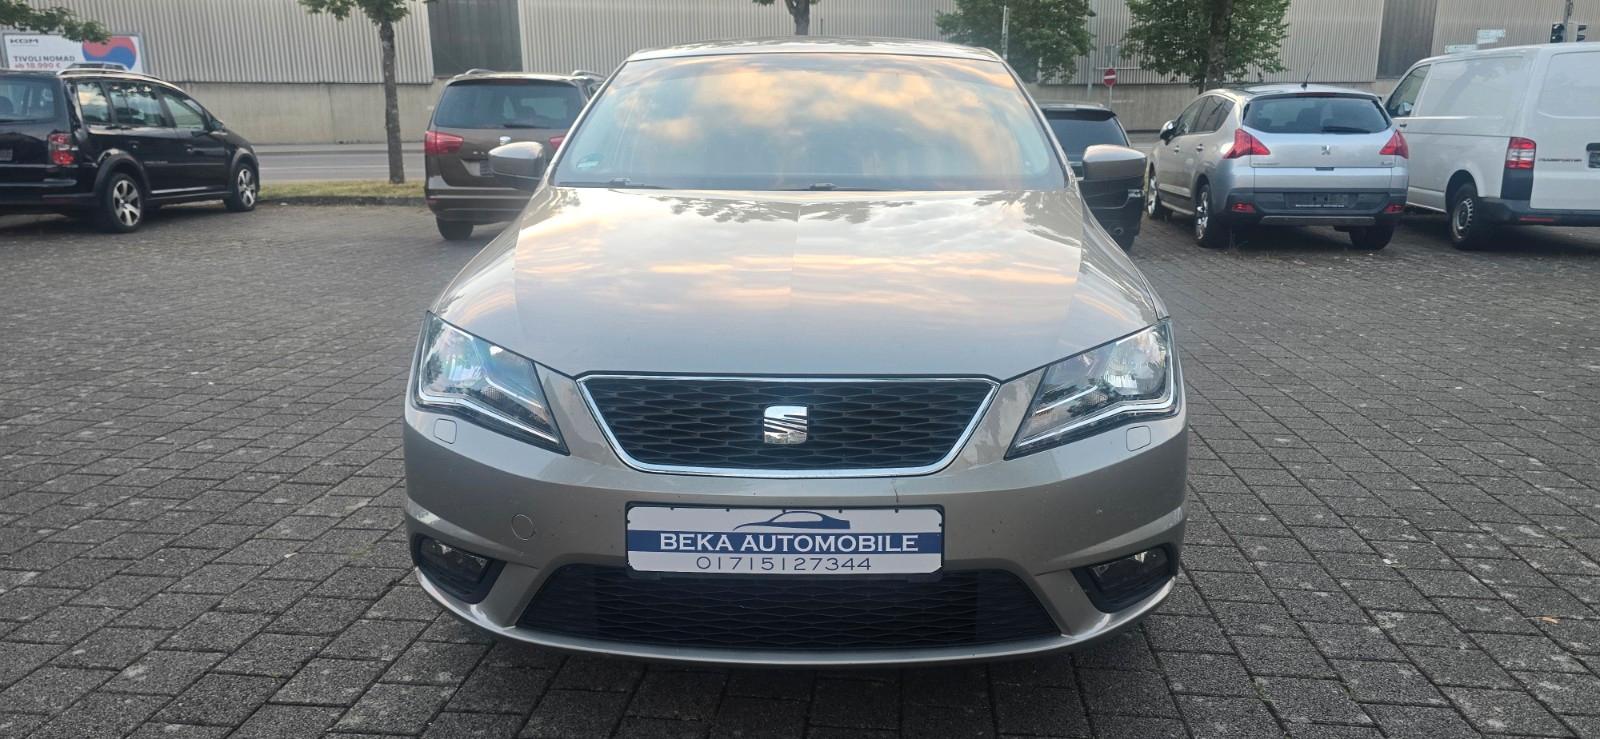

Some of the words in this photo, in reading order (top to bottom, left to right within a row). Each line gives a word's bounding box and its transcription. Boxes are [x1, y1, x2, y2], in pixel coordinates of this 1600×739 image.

[659, 533, 733, 551] BEKA
[741, 534, 919, 552] AUTOMOBILE
[696, 556, 872, 571] 01715127344
